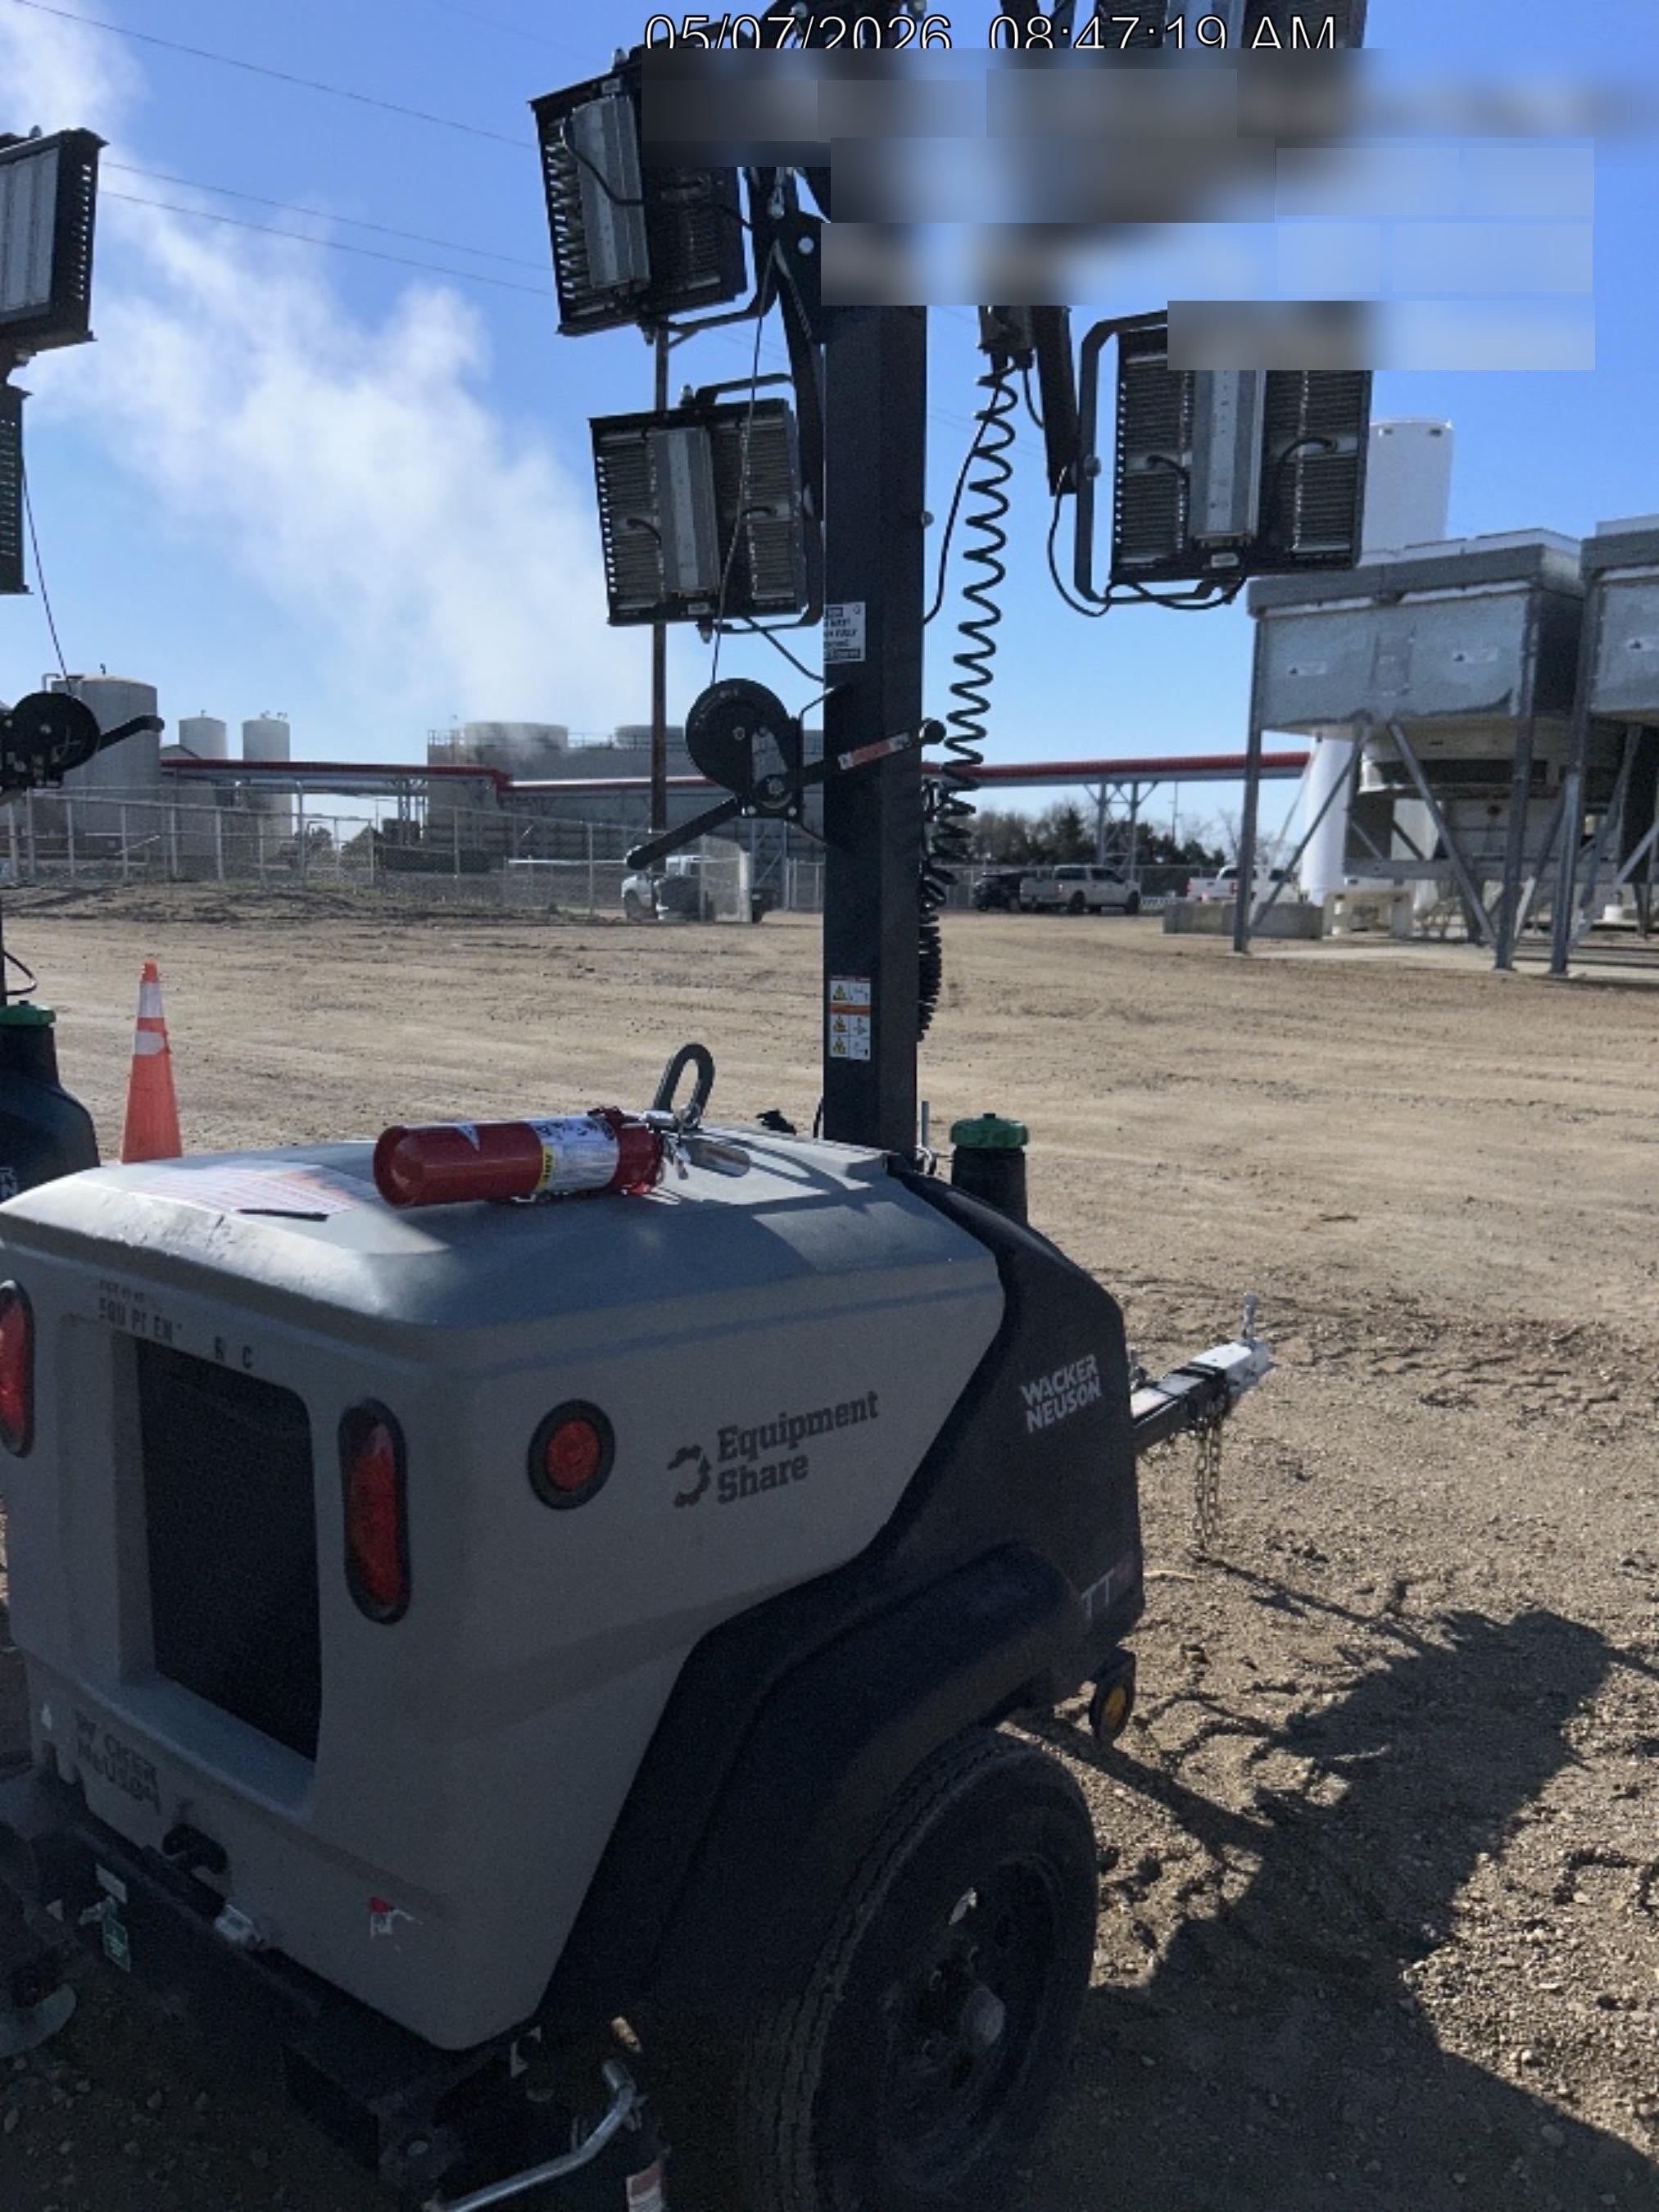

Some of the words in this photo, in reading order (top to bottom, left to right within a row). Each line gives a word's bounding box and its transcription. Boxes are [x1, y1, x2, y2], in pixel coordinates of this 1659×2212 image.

[1021, 1353, 1099, 1407] WACKER
[1026, 1376, 1102, 1432] NEUSON
[718, 1390, 879, 1463] Equipment
[717, 1454, 809, 1506] Share
